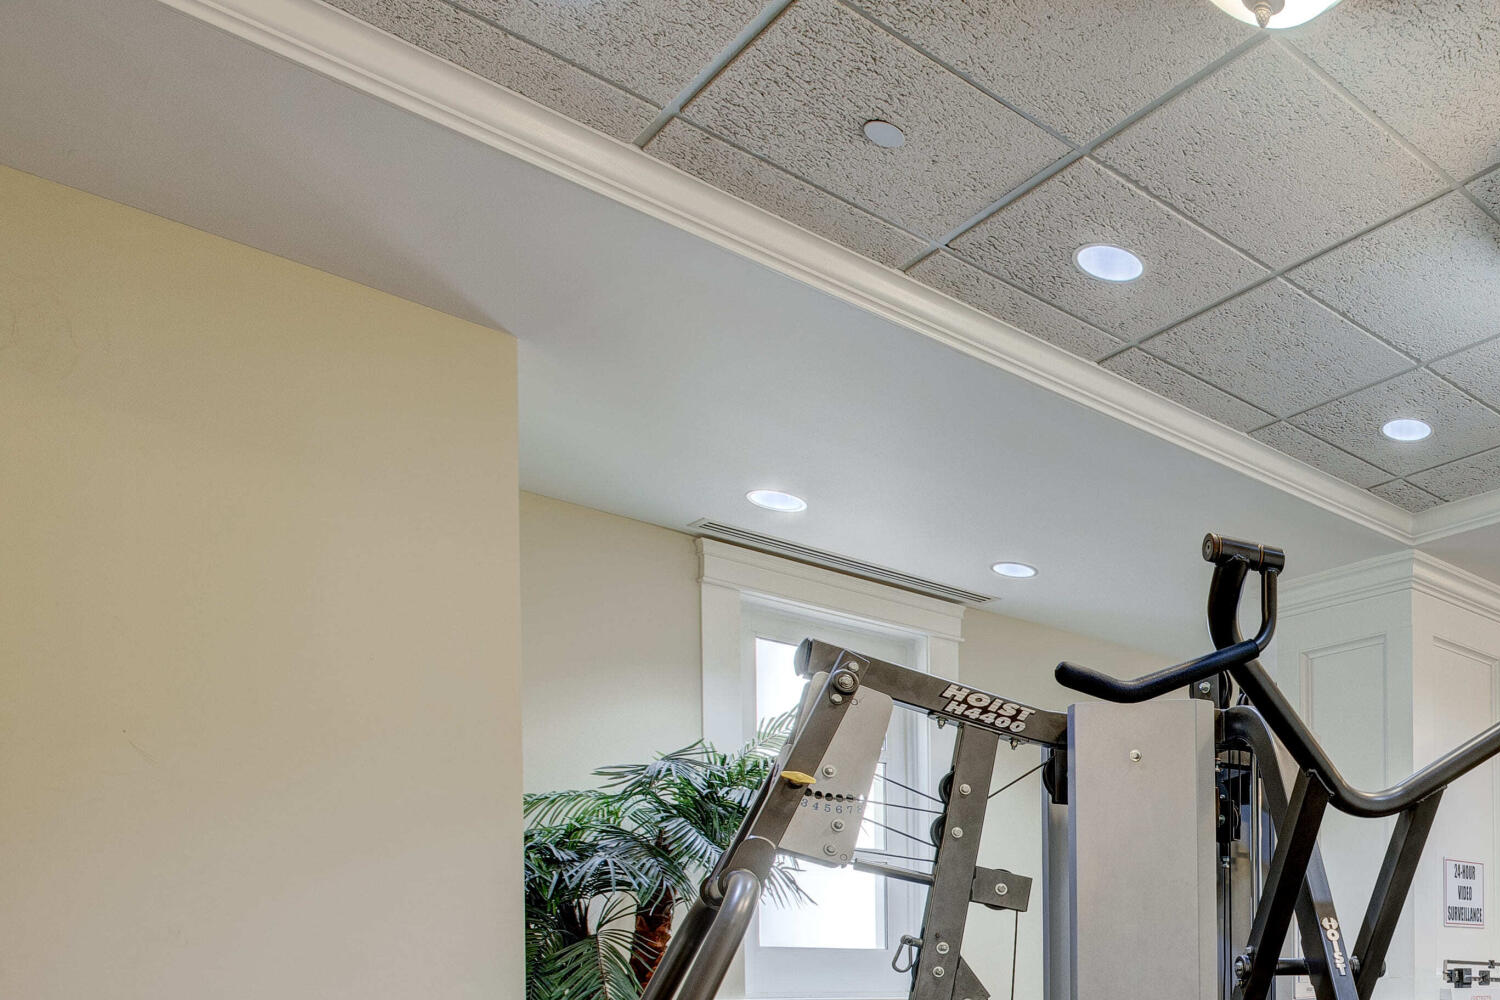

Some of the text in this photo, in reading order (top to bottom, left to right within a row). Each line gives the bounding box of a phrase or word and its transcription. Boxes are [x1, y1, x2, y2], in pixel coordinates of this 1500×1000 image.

[942, 683, 1036, 722] HOIST
[944, 701, 1026, 733] H4400
[801, 798, 809, 808] 3
[812, 802, 819, 811] 4
[824, 803, 831, 813] 5
[835, 805, 843, 814] 6
[846, 805, 854, 815] 7
[1453, 863, 1476, 880] 24-HOUR
[1457, 885, 1473, 901] VIDEO
[1447, 905, 1482, 923] SURVEILLANCE
[1321, 917, 1346, 976] HOIST
